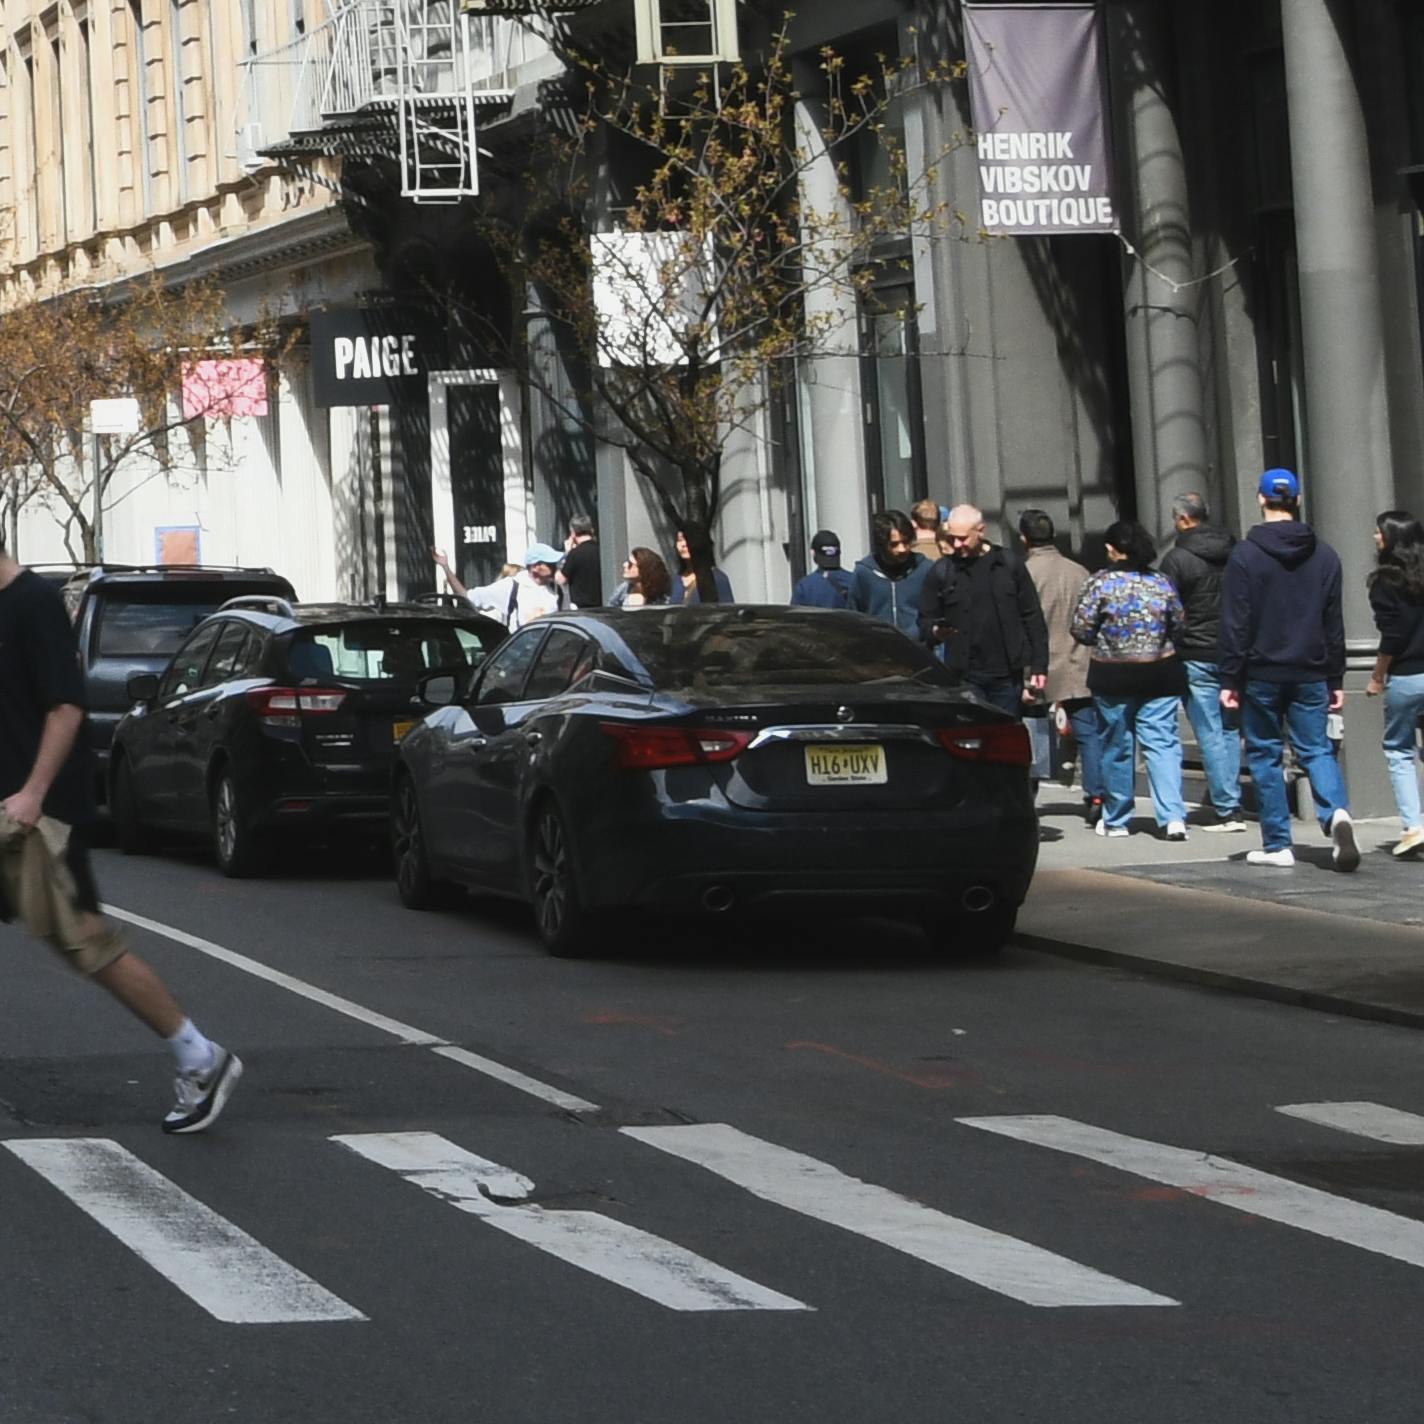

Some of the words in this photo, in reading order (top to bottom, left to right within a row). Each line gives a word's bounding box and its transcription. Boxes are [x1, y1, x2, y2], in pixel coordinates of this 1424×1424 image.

[977, 132, 1074, 160] HENRIK
[980, 164, 1092, 193] VIBSKOV
[981, 196, 1113, 226] BOUTIQUE
[334, 335, 418, 380] PAIGE
[811, 755, 840, 775] H16
[851, 754, 879, 774] UXV
